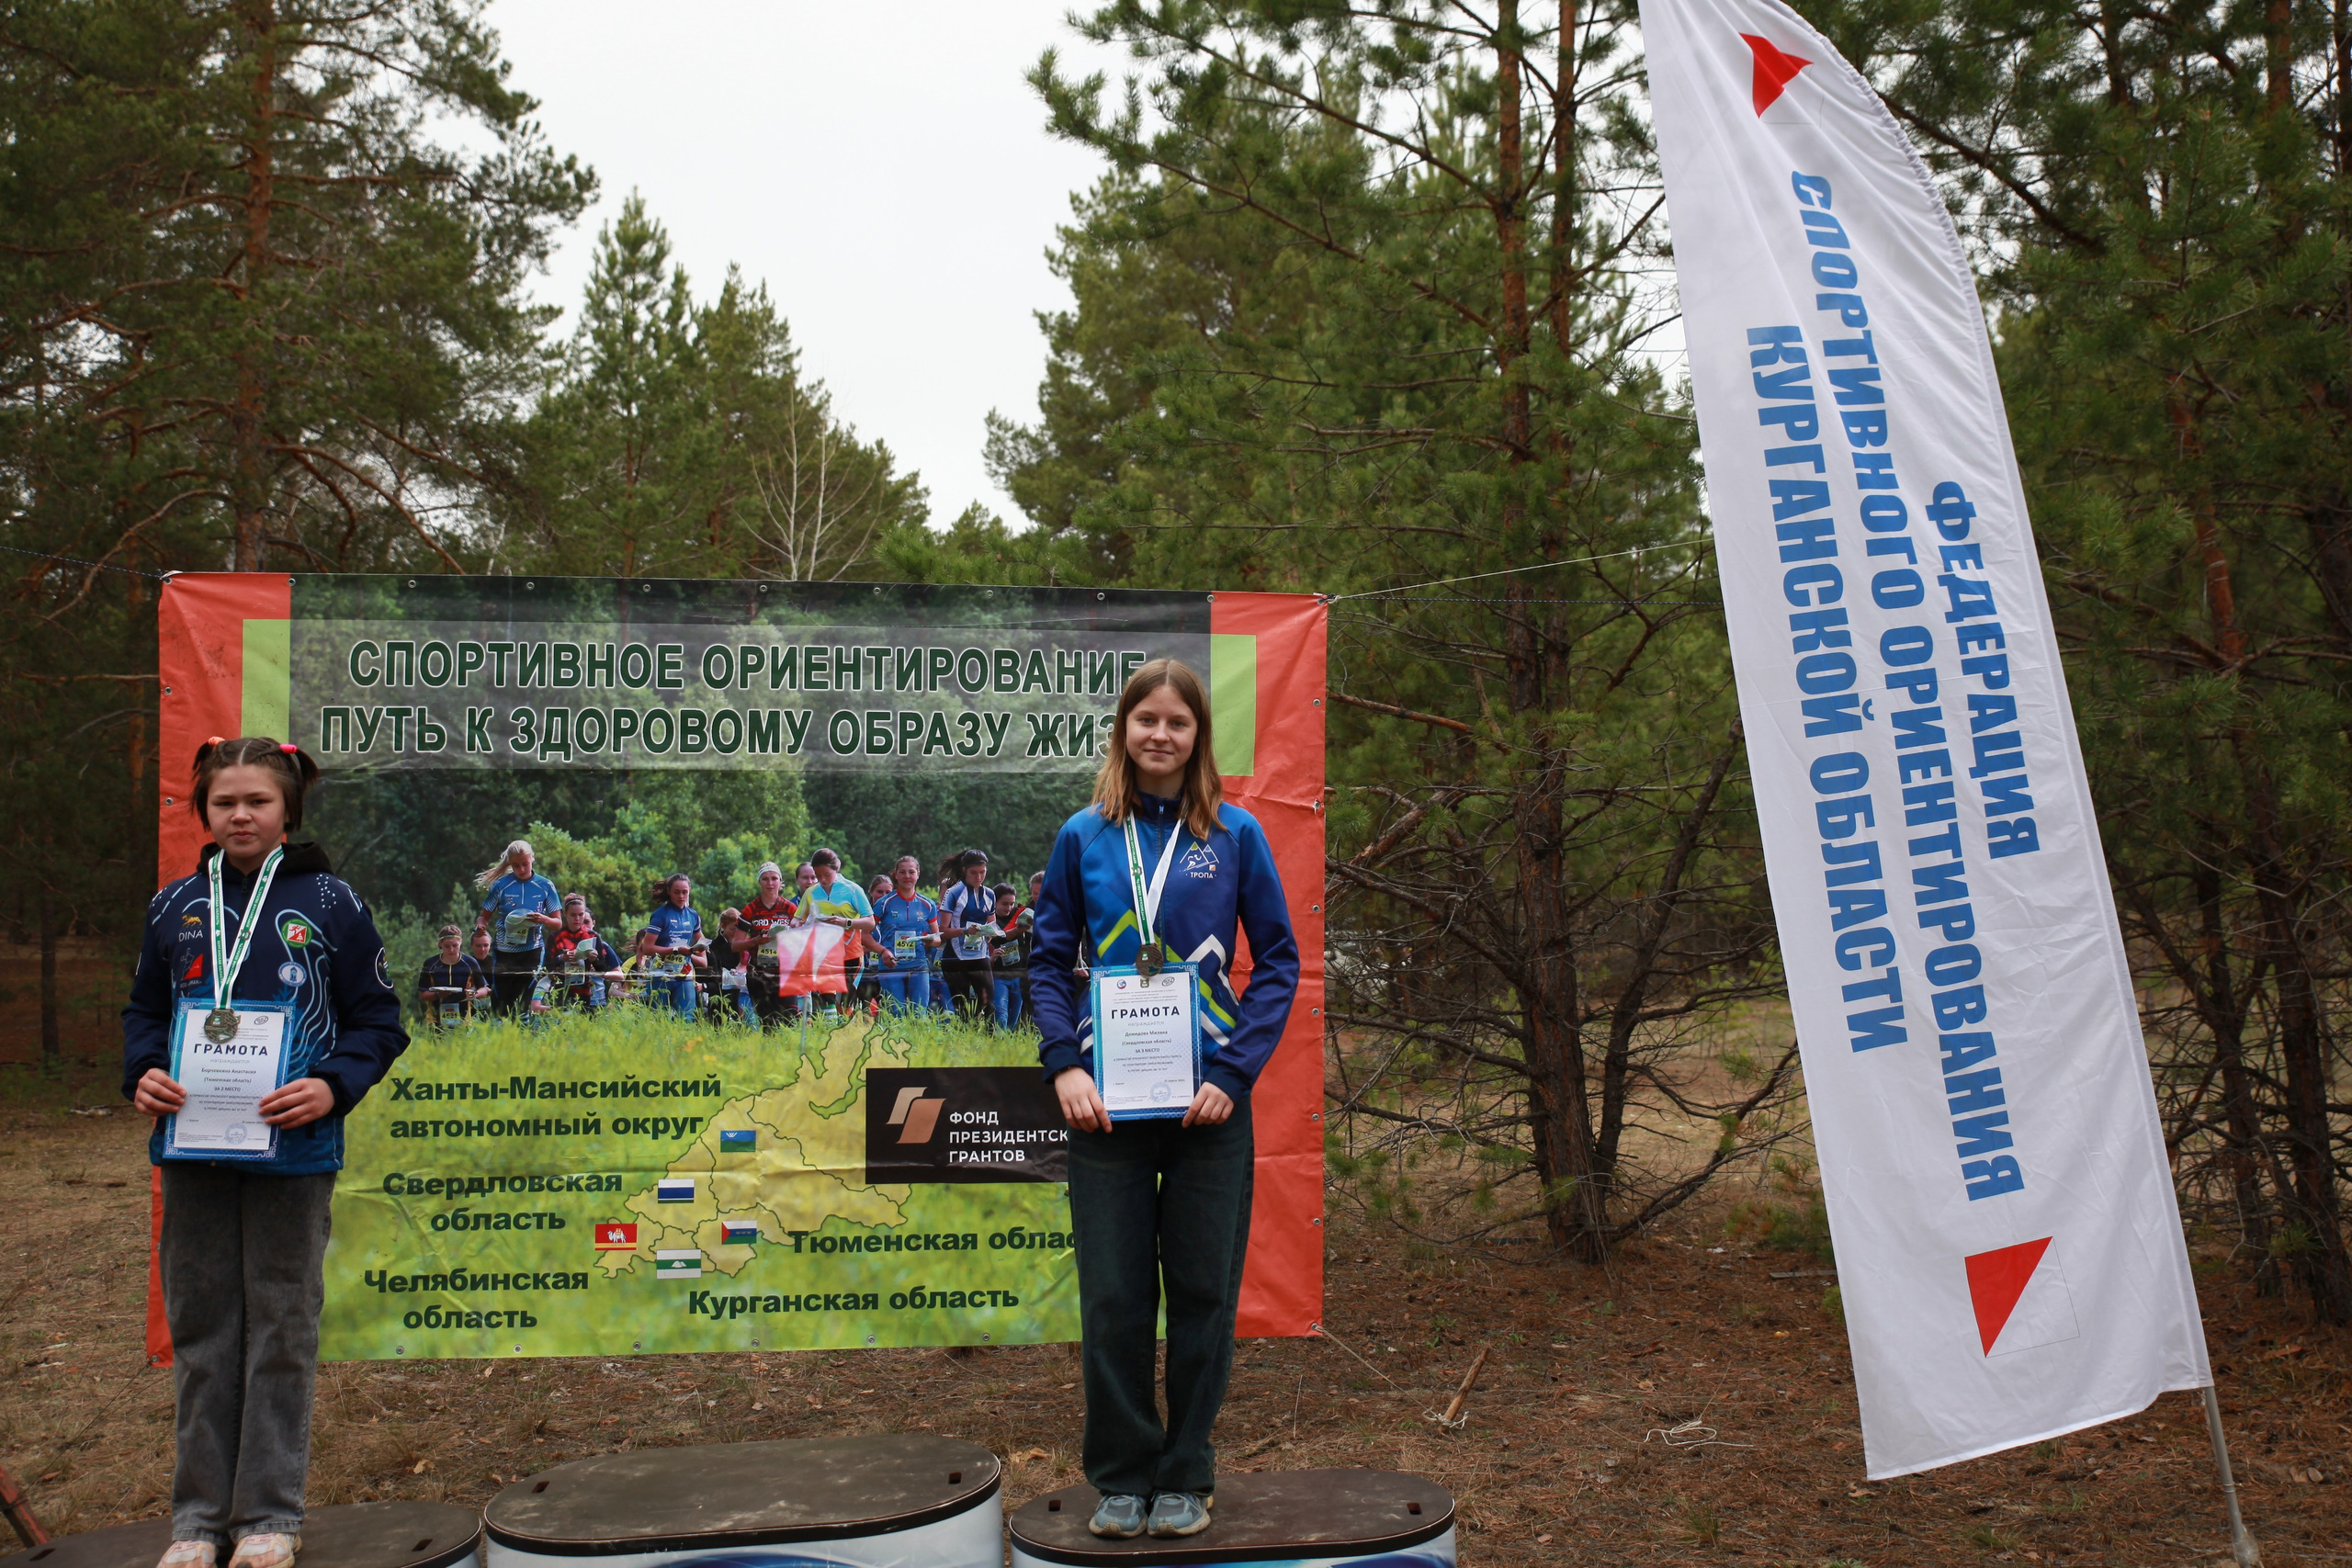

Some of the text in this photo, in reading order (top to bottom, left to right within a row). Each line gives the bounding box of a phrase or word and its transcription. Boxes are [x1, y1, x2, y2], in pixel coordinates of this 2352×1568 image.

[349, 639, 1146, 695] СПОРТИВНОЕ ОРИЕНТИРОВАНИЕ
[1926, 480, 2040, 859] ФЕДЕРАЦИЯ
[1746, 325, 1908, 1053] КУРГАНСКОЙ ОБЛАСТИ
[1791, 170, 2025, 1201] СПОРТИВНОГО ОРИЕНТИРОВАНИЯ
[321, 705, 447, 753] ПУТЬ
[466, 706, 494, 753] К
[509, 705, 813, 761] ЗДОРОВОМУ
[828, 709, 1012, 757] ОБРАЗУ
[178, 930, 203, 942] DINA
[1111, 1006, 1180, 1020] ГРАМОТА
[194, 1043, 268, 1056] ГРАМОТА
[390, 1074, 721, 1101] Ханты-Мансийский
[390, 1111, 704, 1140] автономный округ
[949, 1111, 1000, 1126] ФОНД
[949, 1129, 1069, 1145] ПРЕЗИДЕНТСК
[949, 1148, 1025, 1164] ГРАНТОВ
[382, 1172, 623, 1201] Свердловская
[430, 1208, 566, 1233] область
[788, 1229, 978, 1254] Тюменская
[364, 1268, 589, 1293] Челябинская
[689, 1285, 1019, 1320] Курганская область
[402, 1304, 537, 1330] область
